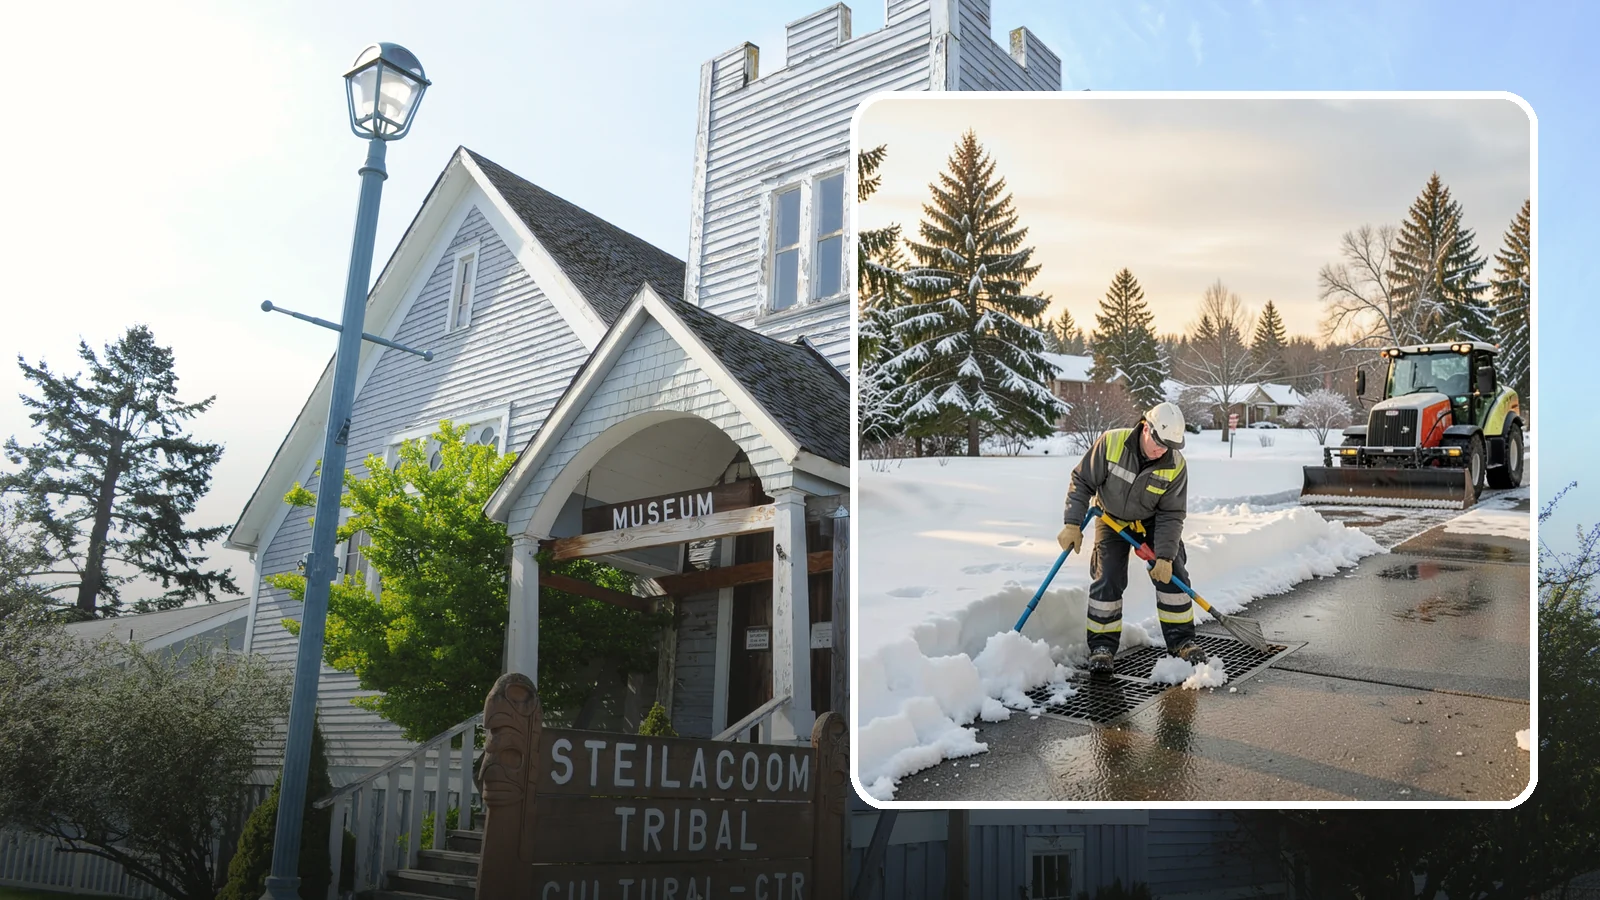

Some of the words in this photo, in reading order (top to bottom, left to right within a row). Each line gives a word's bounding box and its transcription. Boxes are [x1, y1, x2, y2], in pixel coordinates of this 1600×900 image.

[613, 491, 714, 531] MUSEUM
[550, 738, 809, 792] STEILACOOM
[614, 806, 758, 852] TRIBAL
